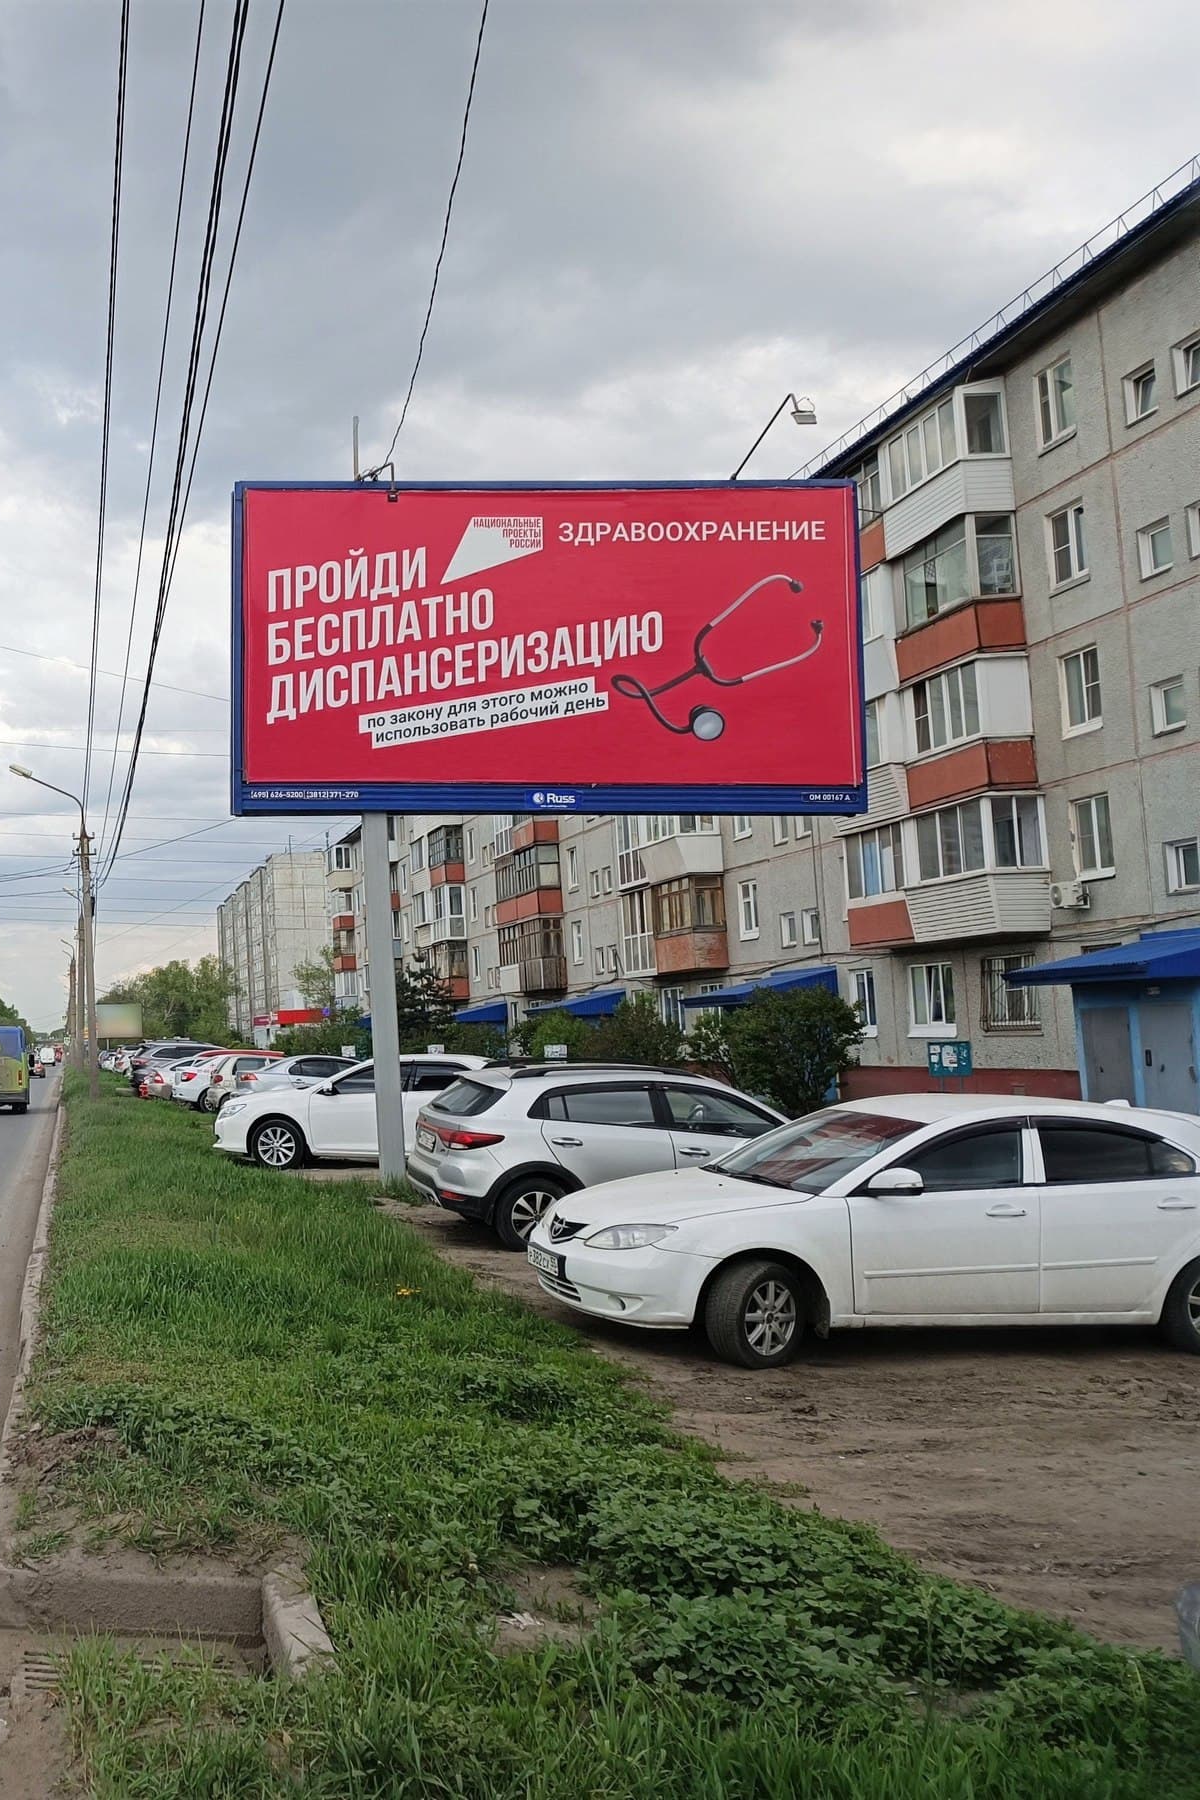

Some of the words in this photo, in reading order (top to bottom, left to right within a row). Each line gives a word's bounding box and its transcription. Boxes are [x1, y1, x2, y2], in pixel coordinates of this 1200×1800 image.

[473, 518, 541, 529] НАЦИОНАЛЬНЫЕ
[502, 529, 541, 538] ПРОЕКТЫ
[558, 520, 826, 546] ЗДРАВООХРАНЕНИЕ
[509, 539, 541, 548] РОССИИ
[267, 547, 426, 612] ПРОЙДИ
[267, 588, 494, 665] БЕСПЛАТНО
[266, 610, 663, 725] ДИСПАНСЕРИЗАЦИЮ
[367, 716, 386, 729] по
[390, 706, 443, 724] закону
[447, 702, 477, 718] для
[481, 693, 526, 710] этого
[530, 682, 589, 701] можно
[375, 716, 486, 743] использовать
[490, 701, 560, 727] рабочий
[564, 694, 606, 716] день
[546, 792, 576, 804] Russ
